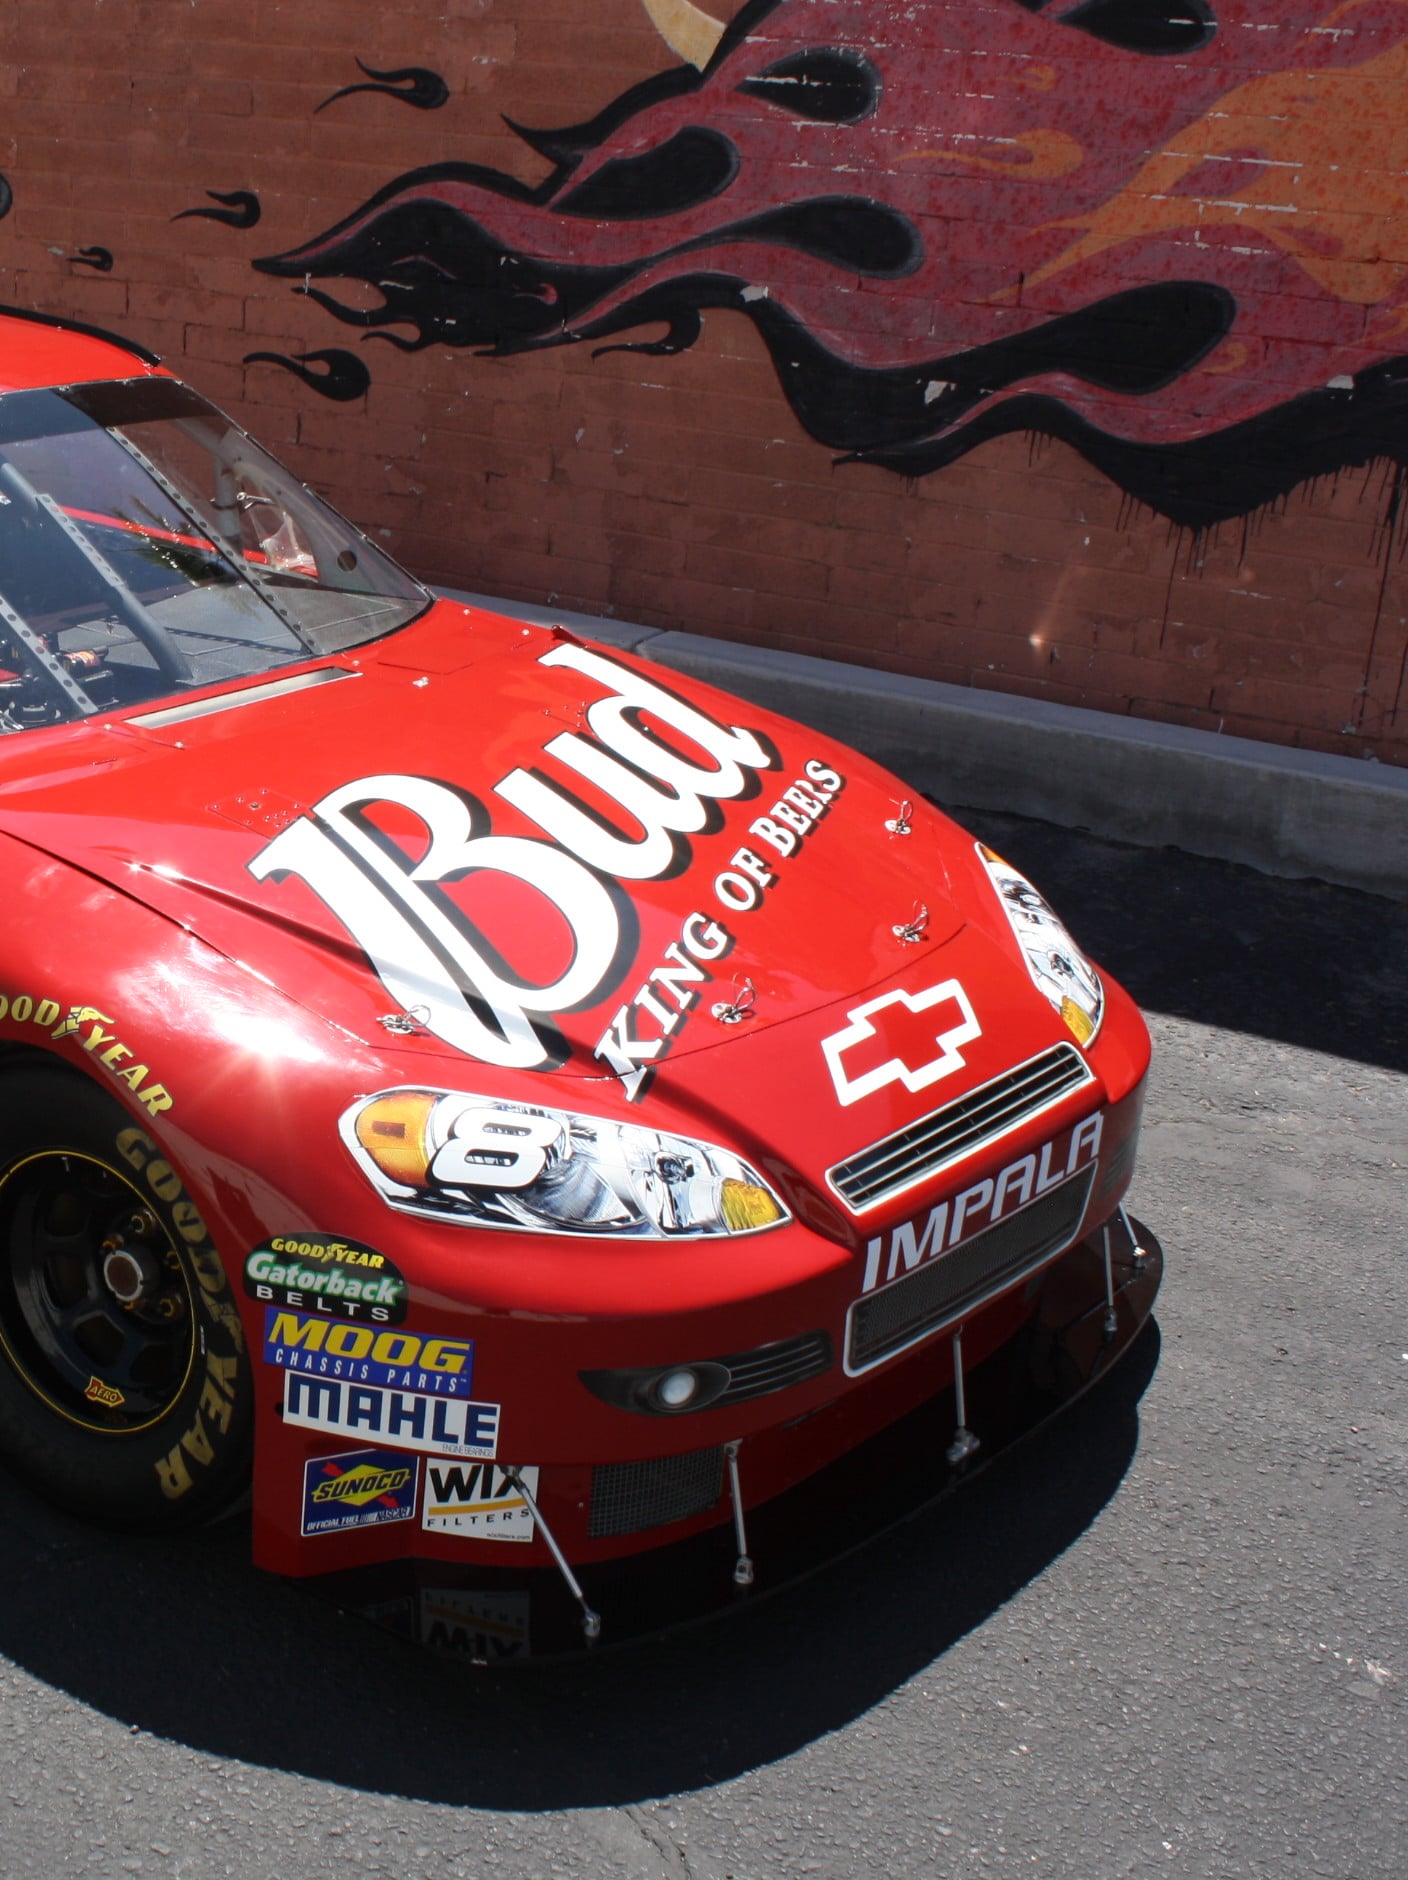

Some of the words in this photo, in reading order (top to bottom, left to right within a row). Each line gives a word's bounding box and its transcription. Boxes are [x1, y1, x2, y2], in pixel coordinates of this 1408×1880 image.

[246, 643, 772, 1070] Bud
[593, 912, 730, 1102] KING
[714, 847, 773, 911] OF
[748, 759, 842, 857] BEERS
[430, 1106, 564, 1188] 8
[861, 1110, 1105, 1293] IMPALA
[246, 1251, 399, 1304] Gatorback
[256, 1285, 389, 1321] BELTS
[268, 1312, 470, 1374] MOOG
[275, 1348, 369, 1379] CHASSIS
[387, 1369, 458, 1393] PARTS
[89, 1386, 118, 1402] AERO
[288, 1373, 498, 1449] MAHLE
[442, 1443, 465, 1454] ENGINE
[465, 1447, 493, 1457] BEARINGS
[316, 1471, 406, 1502] SUNOCO
[429, 1463, 525, 1503] WIX
[307, 1518, 340, 1531] OFFICIAL
[341, 1514, 359, 1526] FUEL
[427, 1508, 530, 1528] FILTERS
